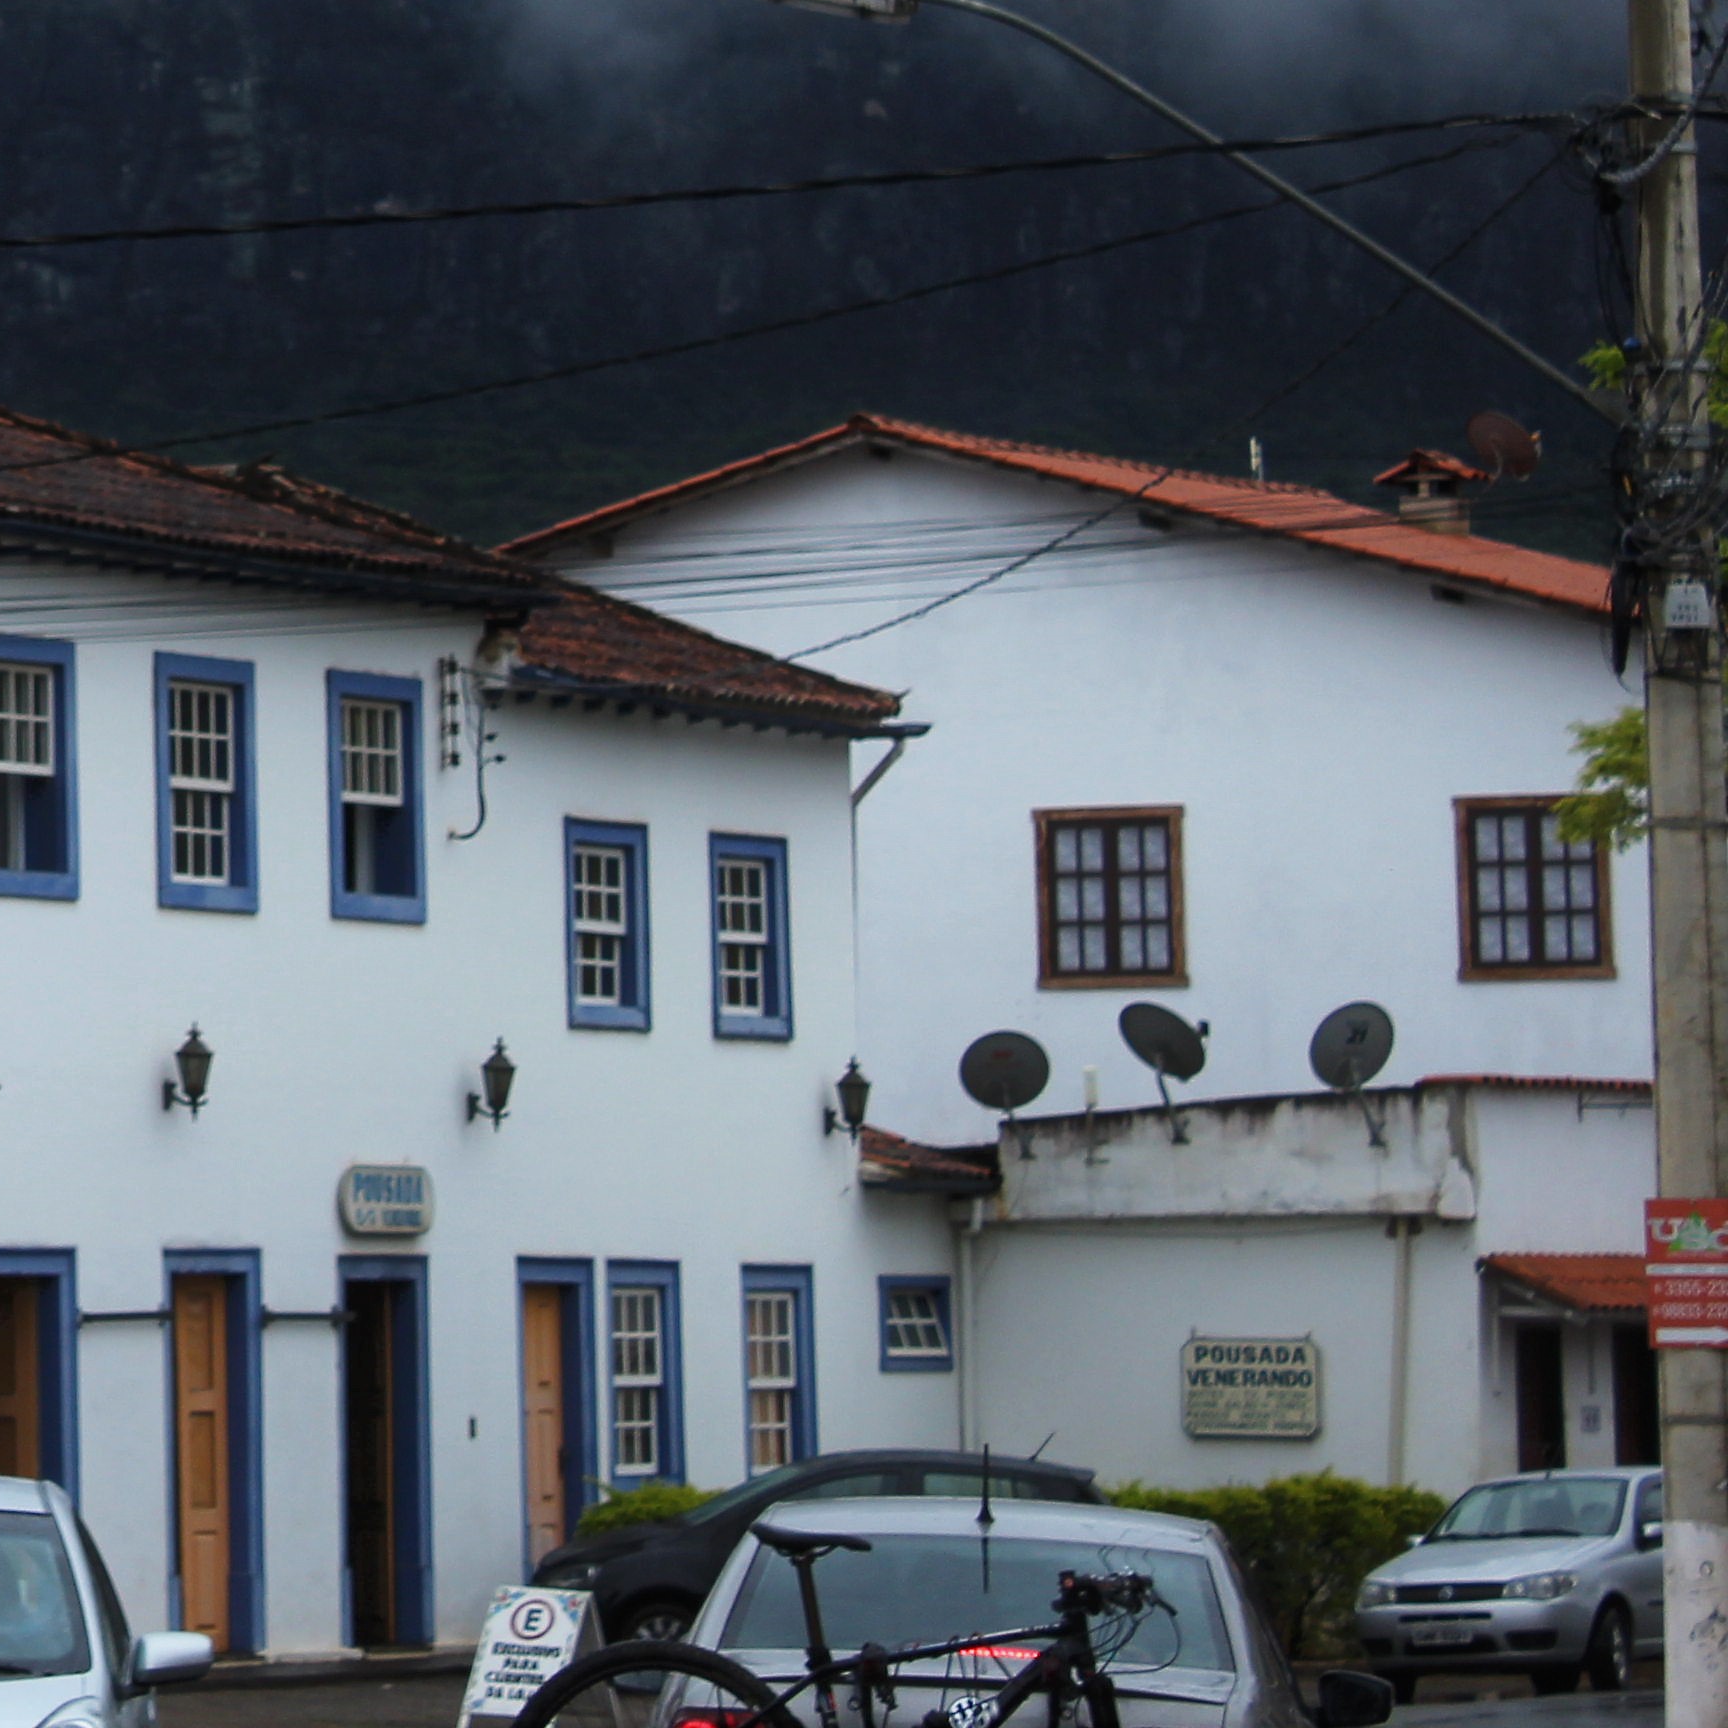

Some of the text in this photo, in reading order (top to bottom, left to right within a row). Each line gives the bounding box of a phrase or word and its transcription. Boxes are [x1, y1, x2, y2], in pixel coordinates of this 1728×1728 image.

[1194, 1345, 1307, 1364] POUSADA
[1187, 1368, 1313, 1388] VENERANDO
[523, 1608, 543, 1631] E
[491, 1641, 562, 1658] EXCLUSIVO
[502, 1658, 539, 1671] PARA
